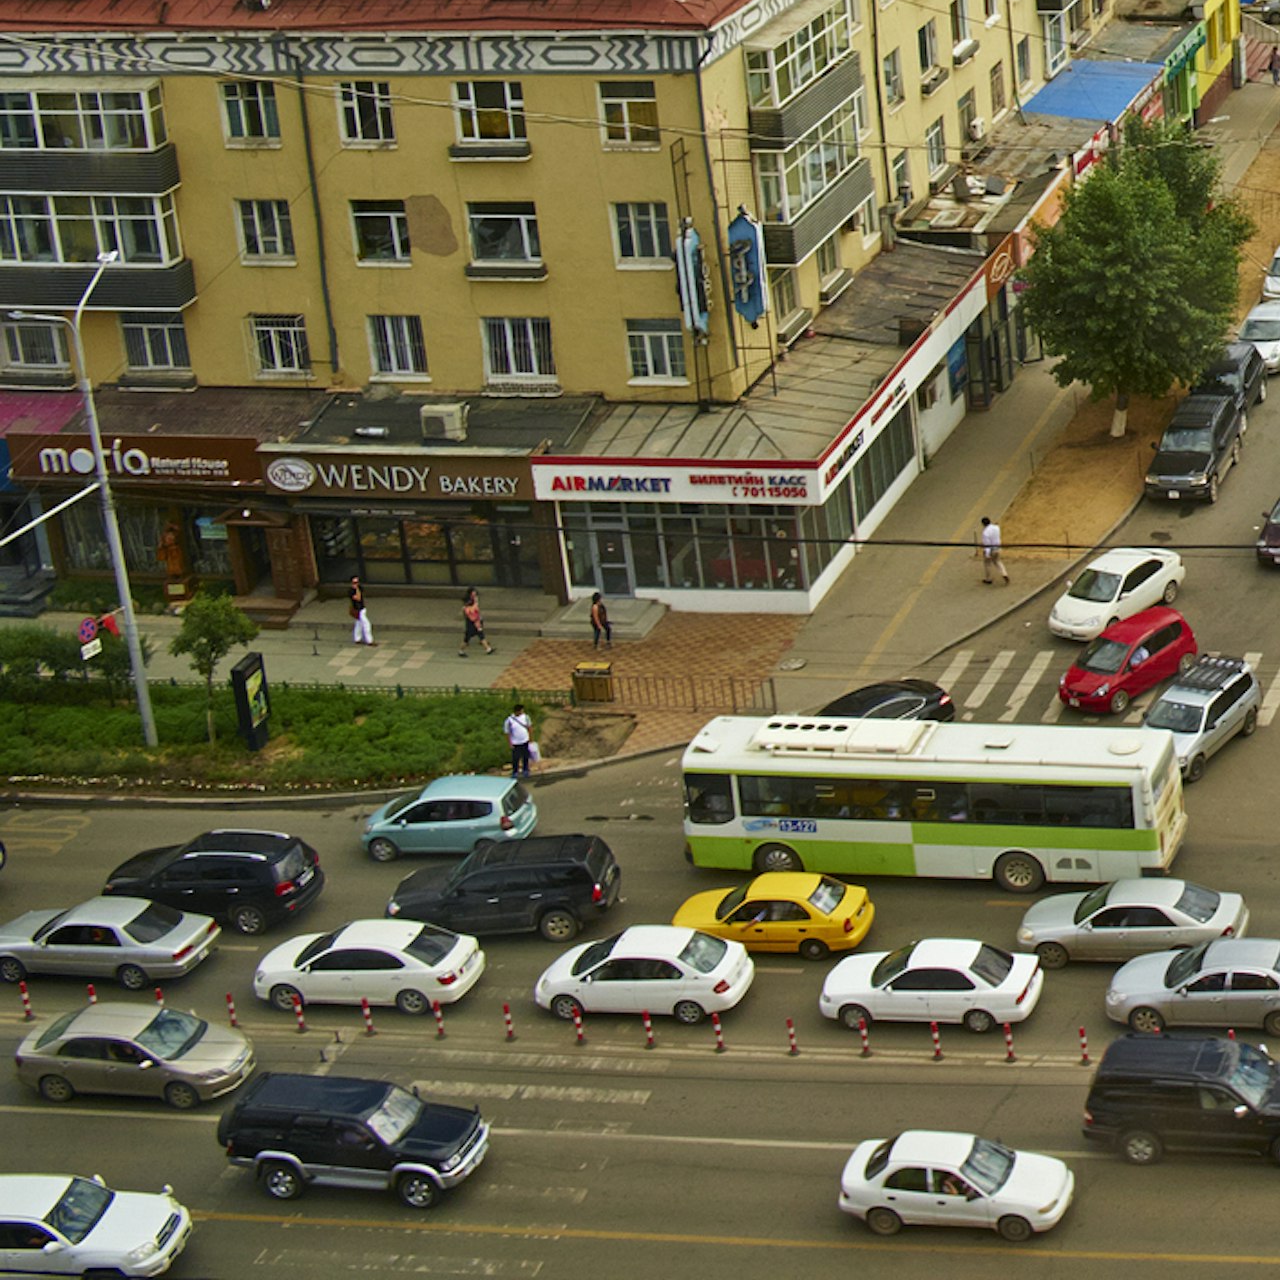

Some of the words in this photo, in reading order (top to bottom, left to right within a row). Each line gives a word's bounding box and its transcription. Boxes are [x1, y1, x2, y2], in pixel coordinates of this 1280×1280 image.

[316, 463, 430, 492] WENDY
[438, 475, 519, 494] BAKERY
[551, 475, 671, 493] AIRMARKET
[689, 472, 764, 485] БИЛЕТИЙН
[768, 475, 807, 486] КАСС
